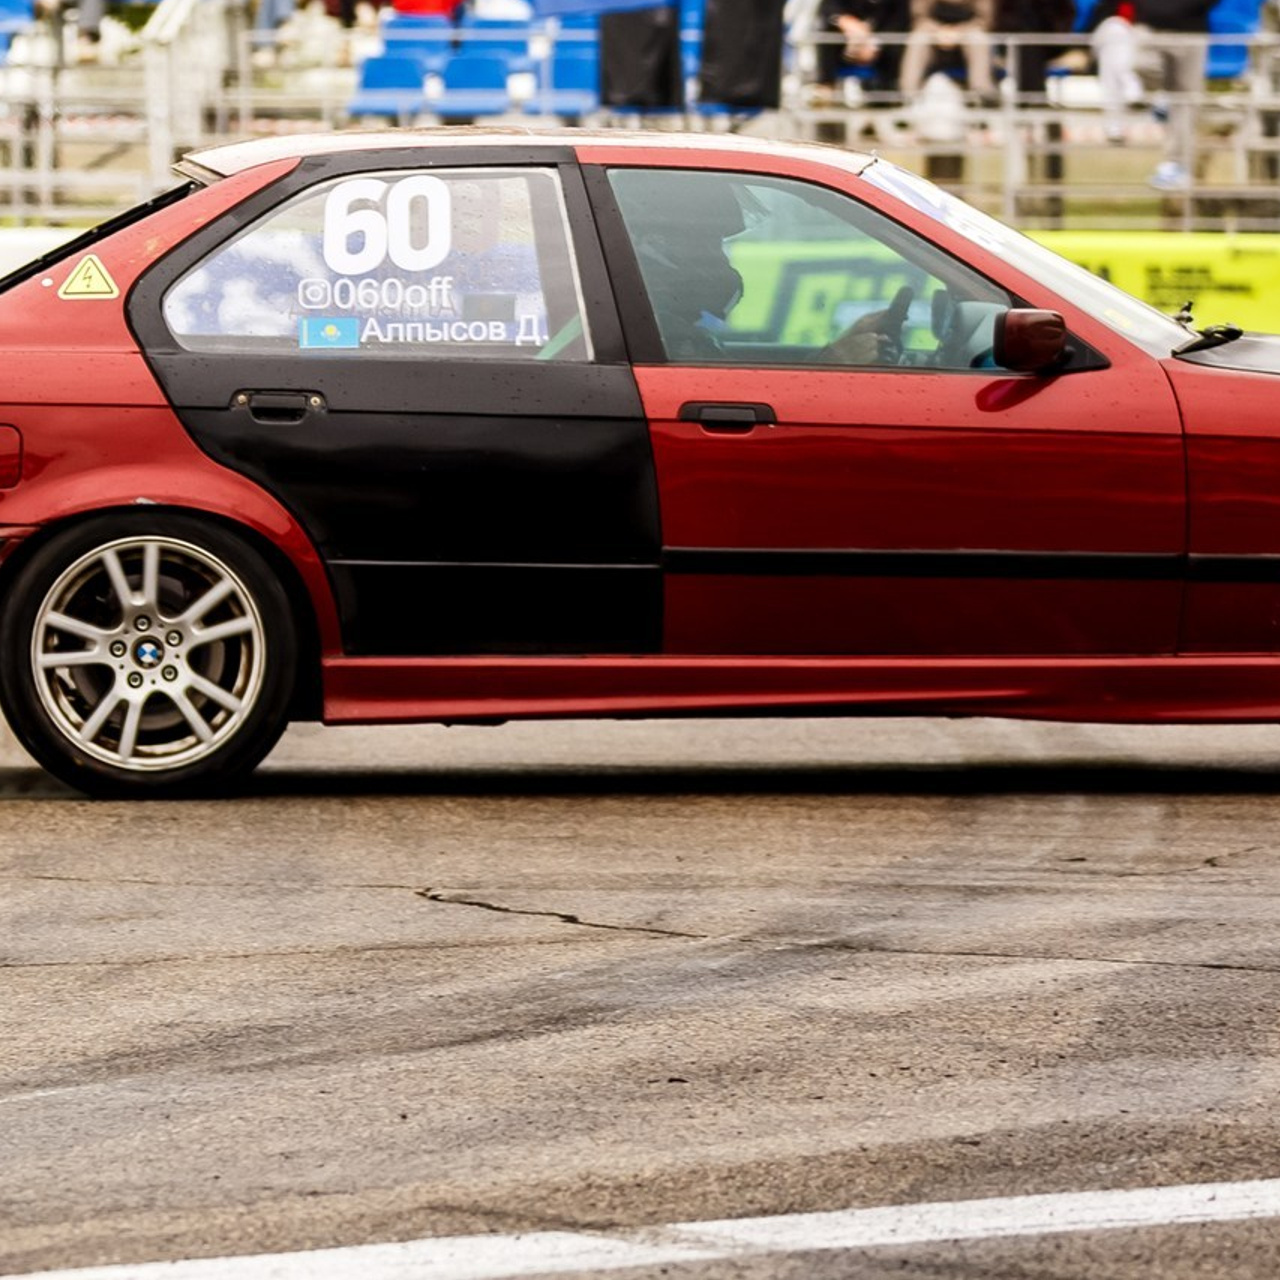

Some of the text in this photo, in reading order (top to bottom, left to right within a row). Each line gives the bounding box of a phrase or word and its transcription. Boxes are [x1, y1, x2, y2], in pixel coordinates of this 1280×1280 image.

[323, 174, 451, 276] 60
[333, 276, 453, 309] 060off
[360, 317, 506, 343] Алпысов
